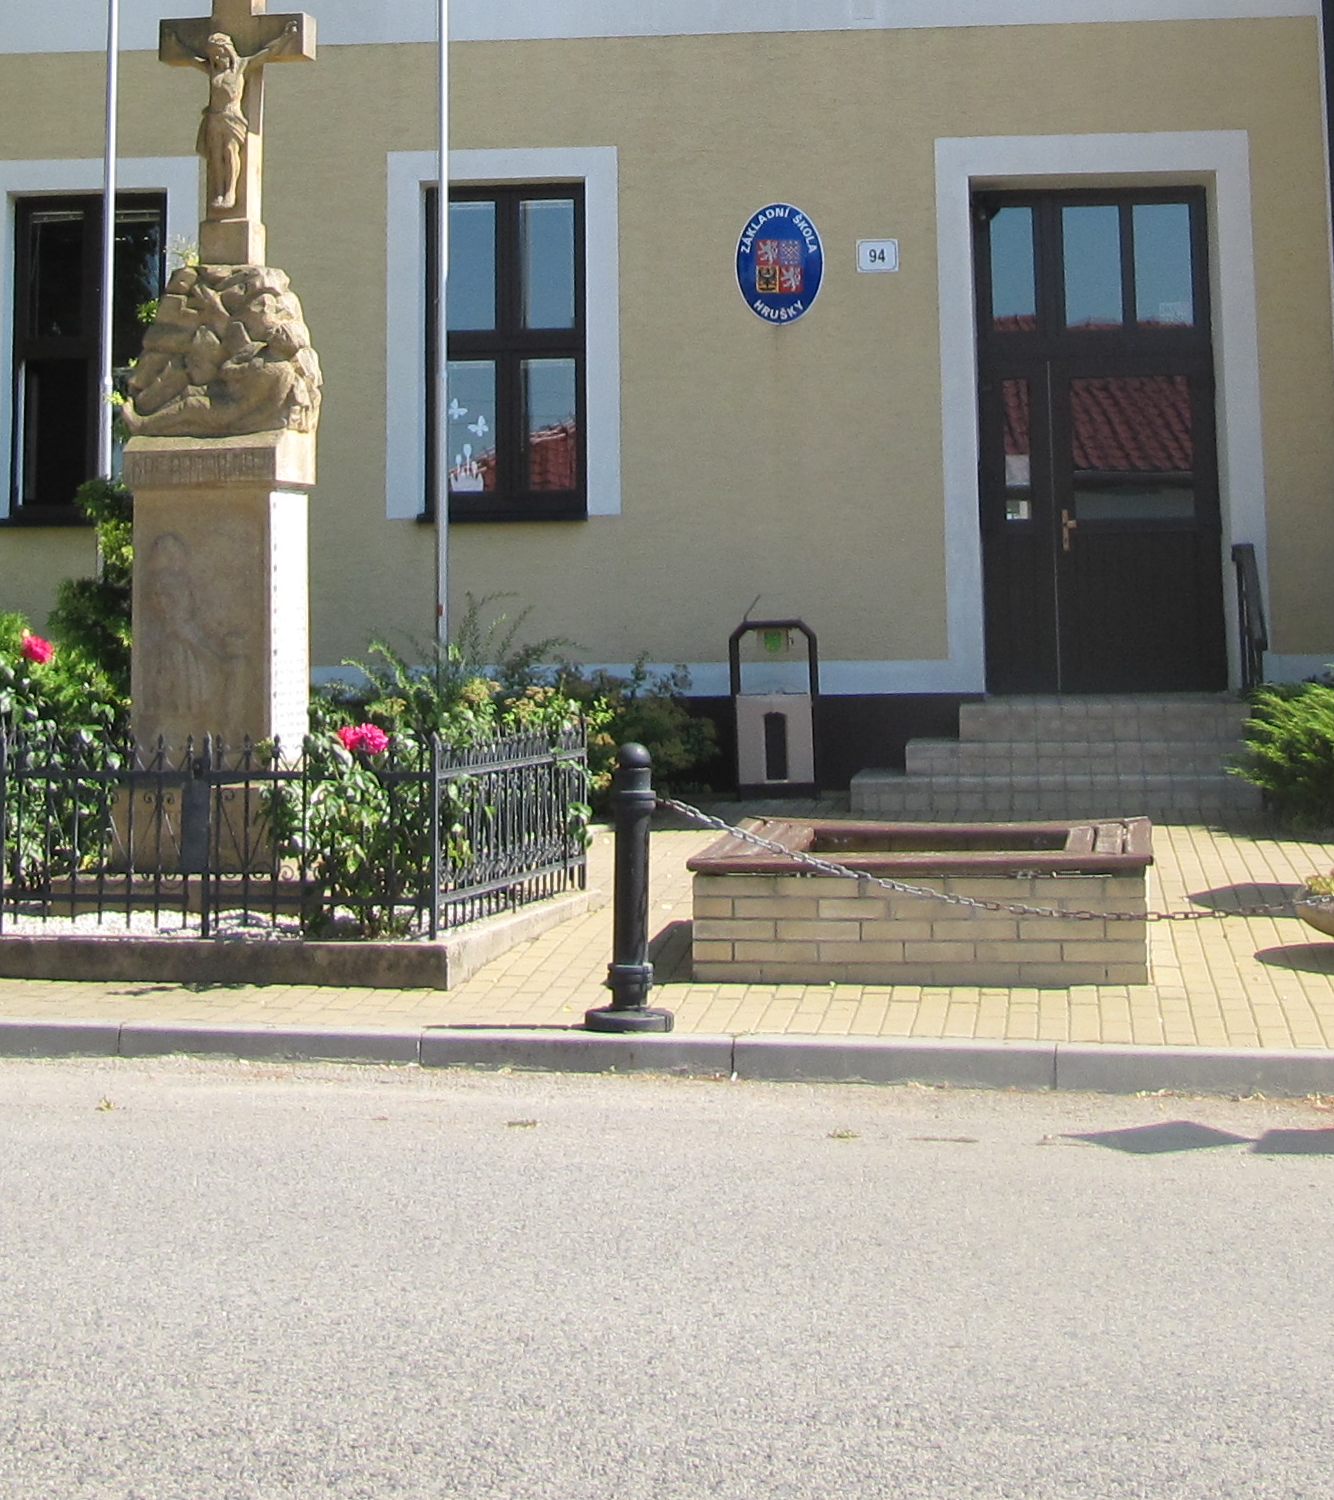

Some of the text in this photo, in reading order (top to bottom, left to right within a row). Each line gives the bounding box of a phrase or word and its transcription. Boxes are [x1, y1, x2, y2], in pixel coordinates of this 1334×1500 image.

[740, 206, 817, 253] ZÁKLADNÍ ŠKOLA
[869, 248, 886, 263] 94
[753, 298, 804, 320] HRUŠKY
